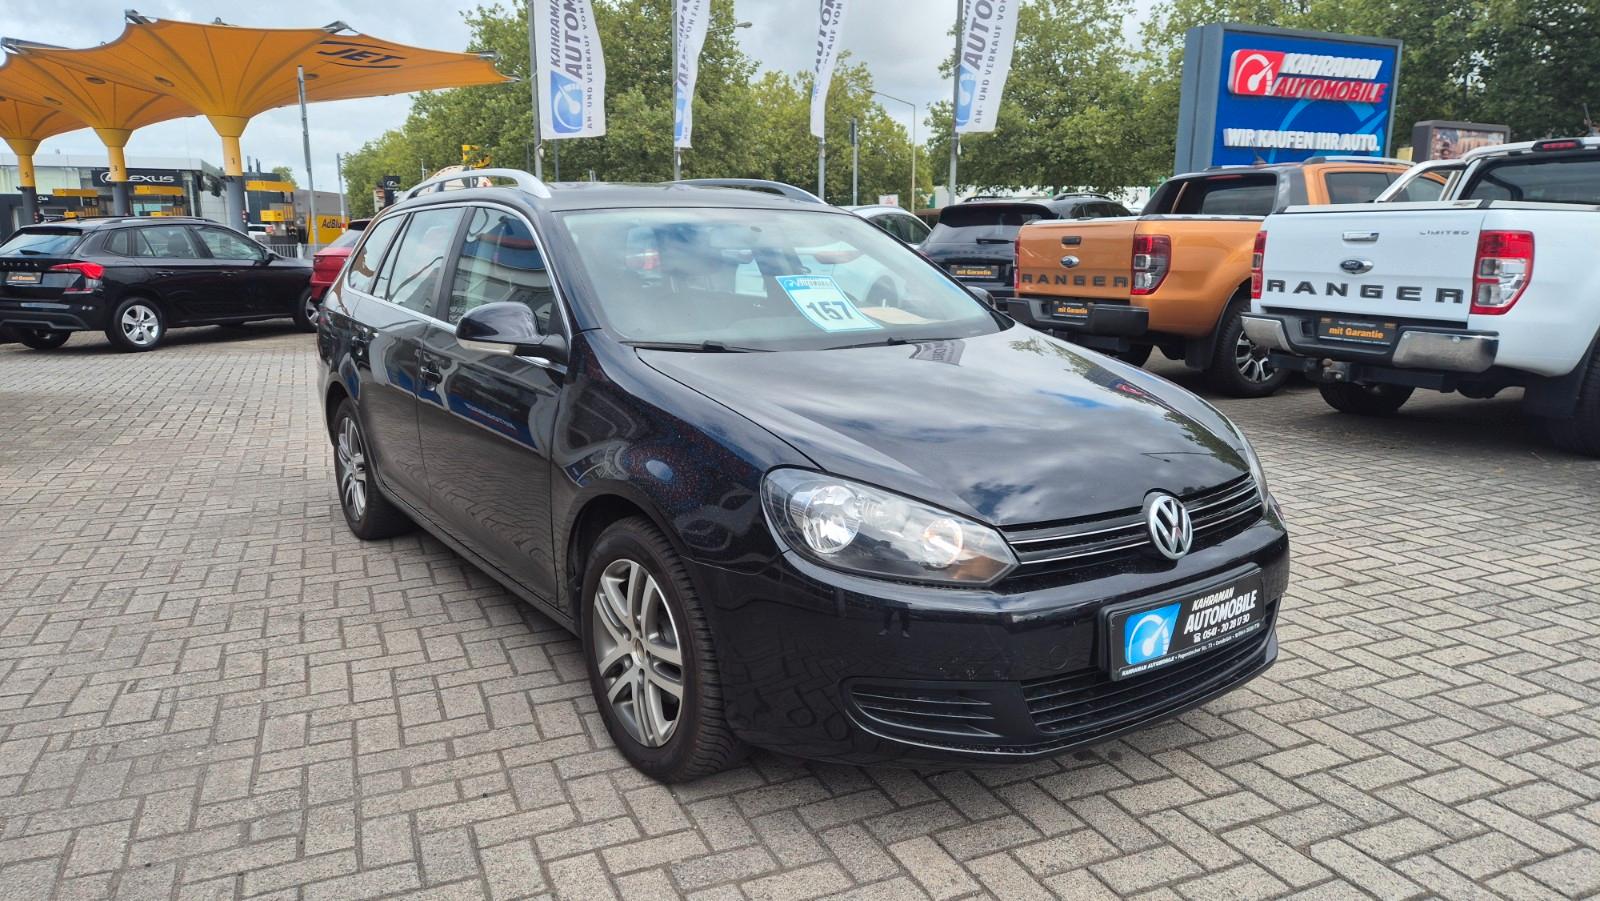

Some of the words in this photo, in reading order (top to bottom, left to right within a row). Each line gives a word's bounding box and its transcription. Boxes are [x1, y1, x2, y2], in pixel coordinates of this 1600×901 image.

[579, 7, 588, 30] VON
[832, 3, 843, 25] VON
[964, 0, 994, 71] AUTO
[316, 48, 408, 63] JET
[584, 36, 593, 83] VERKAUF
[979, 79, 990, 100] UND
[985, 26, 1002, 75] VERKAUF
[1280, 52, 1382, 80] KAHRAMAN
[1271, 77, 1388, 103] AUTOMOBILE
[1223, 128, 1255, 147] WIR
[1256, 129, 1315, 150] KAUFEN
[1316, 132, 1340, 150] IHR
[321, 218, 344, 230] AdBlu
[1022, 273, 1128, 288] RANGER
[1266, 279, 1465, 304] RANGER
[806, 301, 853, 321] 157
[1328, 327, 1344, 335] mit
[1345, 327, 1384, 339] Garantie
[1192, 586, 1235, 611] KAHRAMAN
[1183, 589, 1258, 635] AUTOMOBILE
[1202, 627, 1218, 639] 0541
[1221, 622, 1229, 633] 20
[1242, 613, 1250, 624] 30
